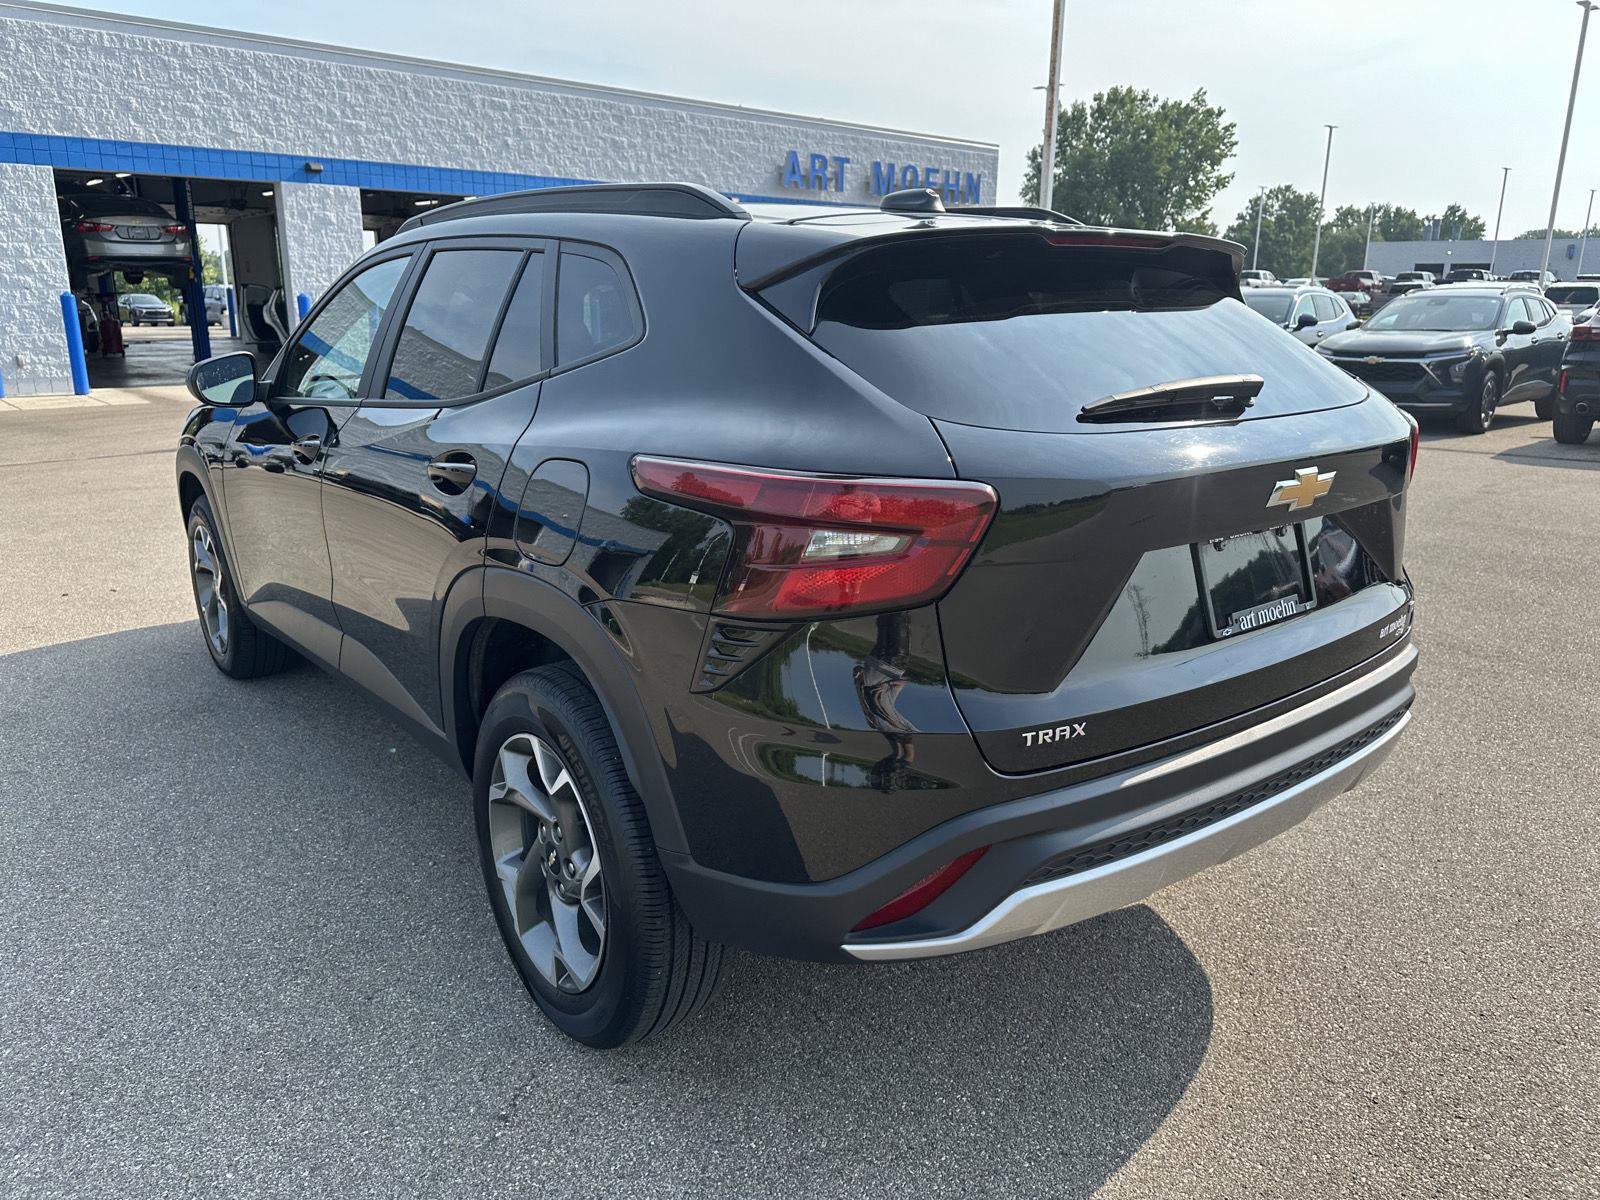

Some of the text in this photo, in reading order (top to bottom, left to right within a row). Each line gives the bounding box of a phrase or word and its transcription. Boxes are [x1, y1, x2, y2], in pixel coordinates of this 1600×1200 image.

[784, 150, 982, 204] ART MOEHN
[1240, 600, 1296, 630] art moehn
[1022, 722, 1087, 746] TRAX
